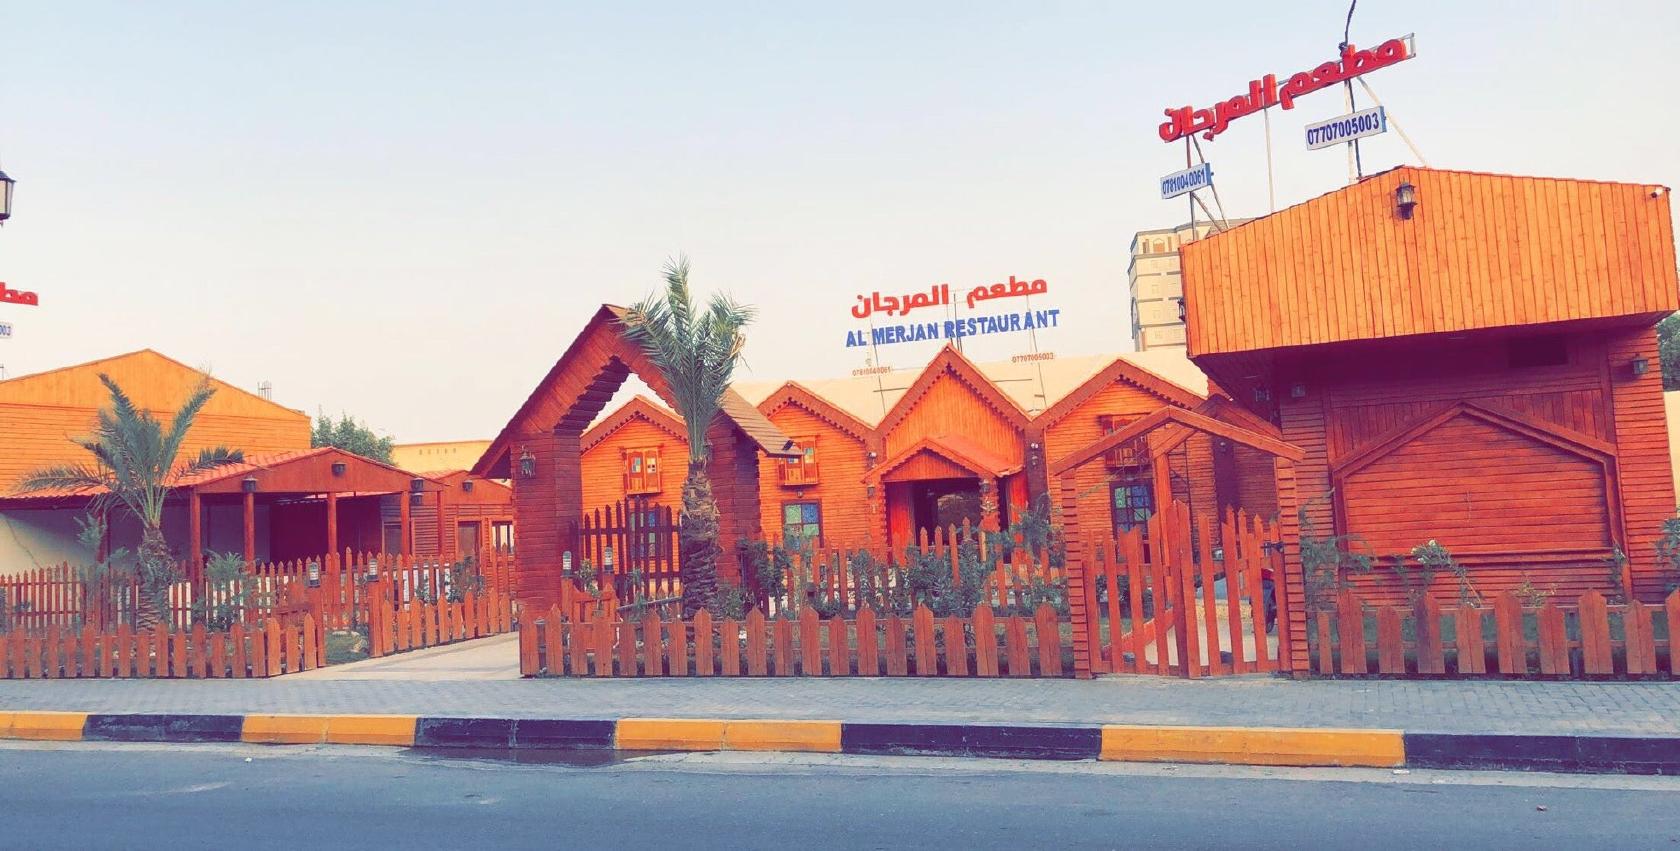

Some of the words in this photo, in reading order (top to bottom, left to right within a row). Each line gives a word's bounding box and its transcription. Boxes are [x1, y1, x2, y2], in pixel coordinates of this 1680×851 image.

[1279, 38, 1408, 110] مطعم
[1159, 73, 1277, 142] المرجان
[1306, 112, 1380, 146] 07707005003
[1162, 167, 1206, 195] 07810040061
[851, 283, 949, 319] المرجان
[966, 275, 1048, 308] مطعم
[846, 330, 867, 347] AL
[872, 322, 939, 344] MERJAN
[944, 309, 1060, 338] RESTAURANT
